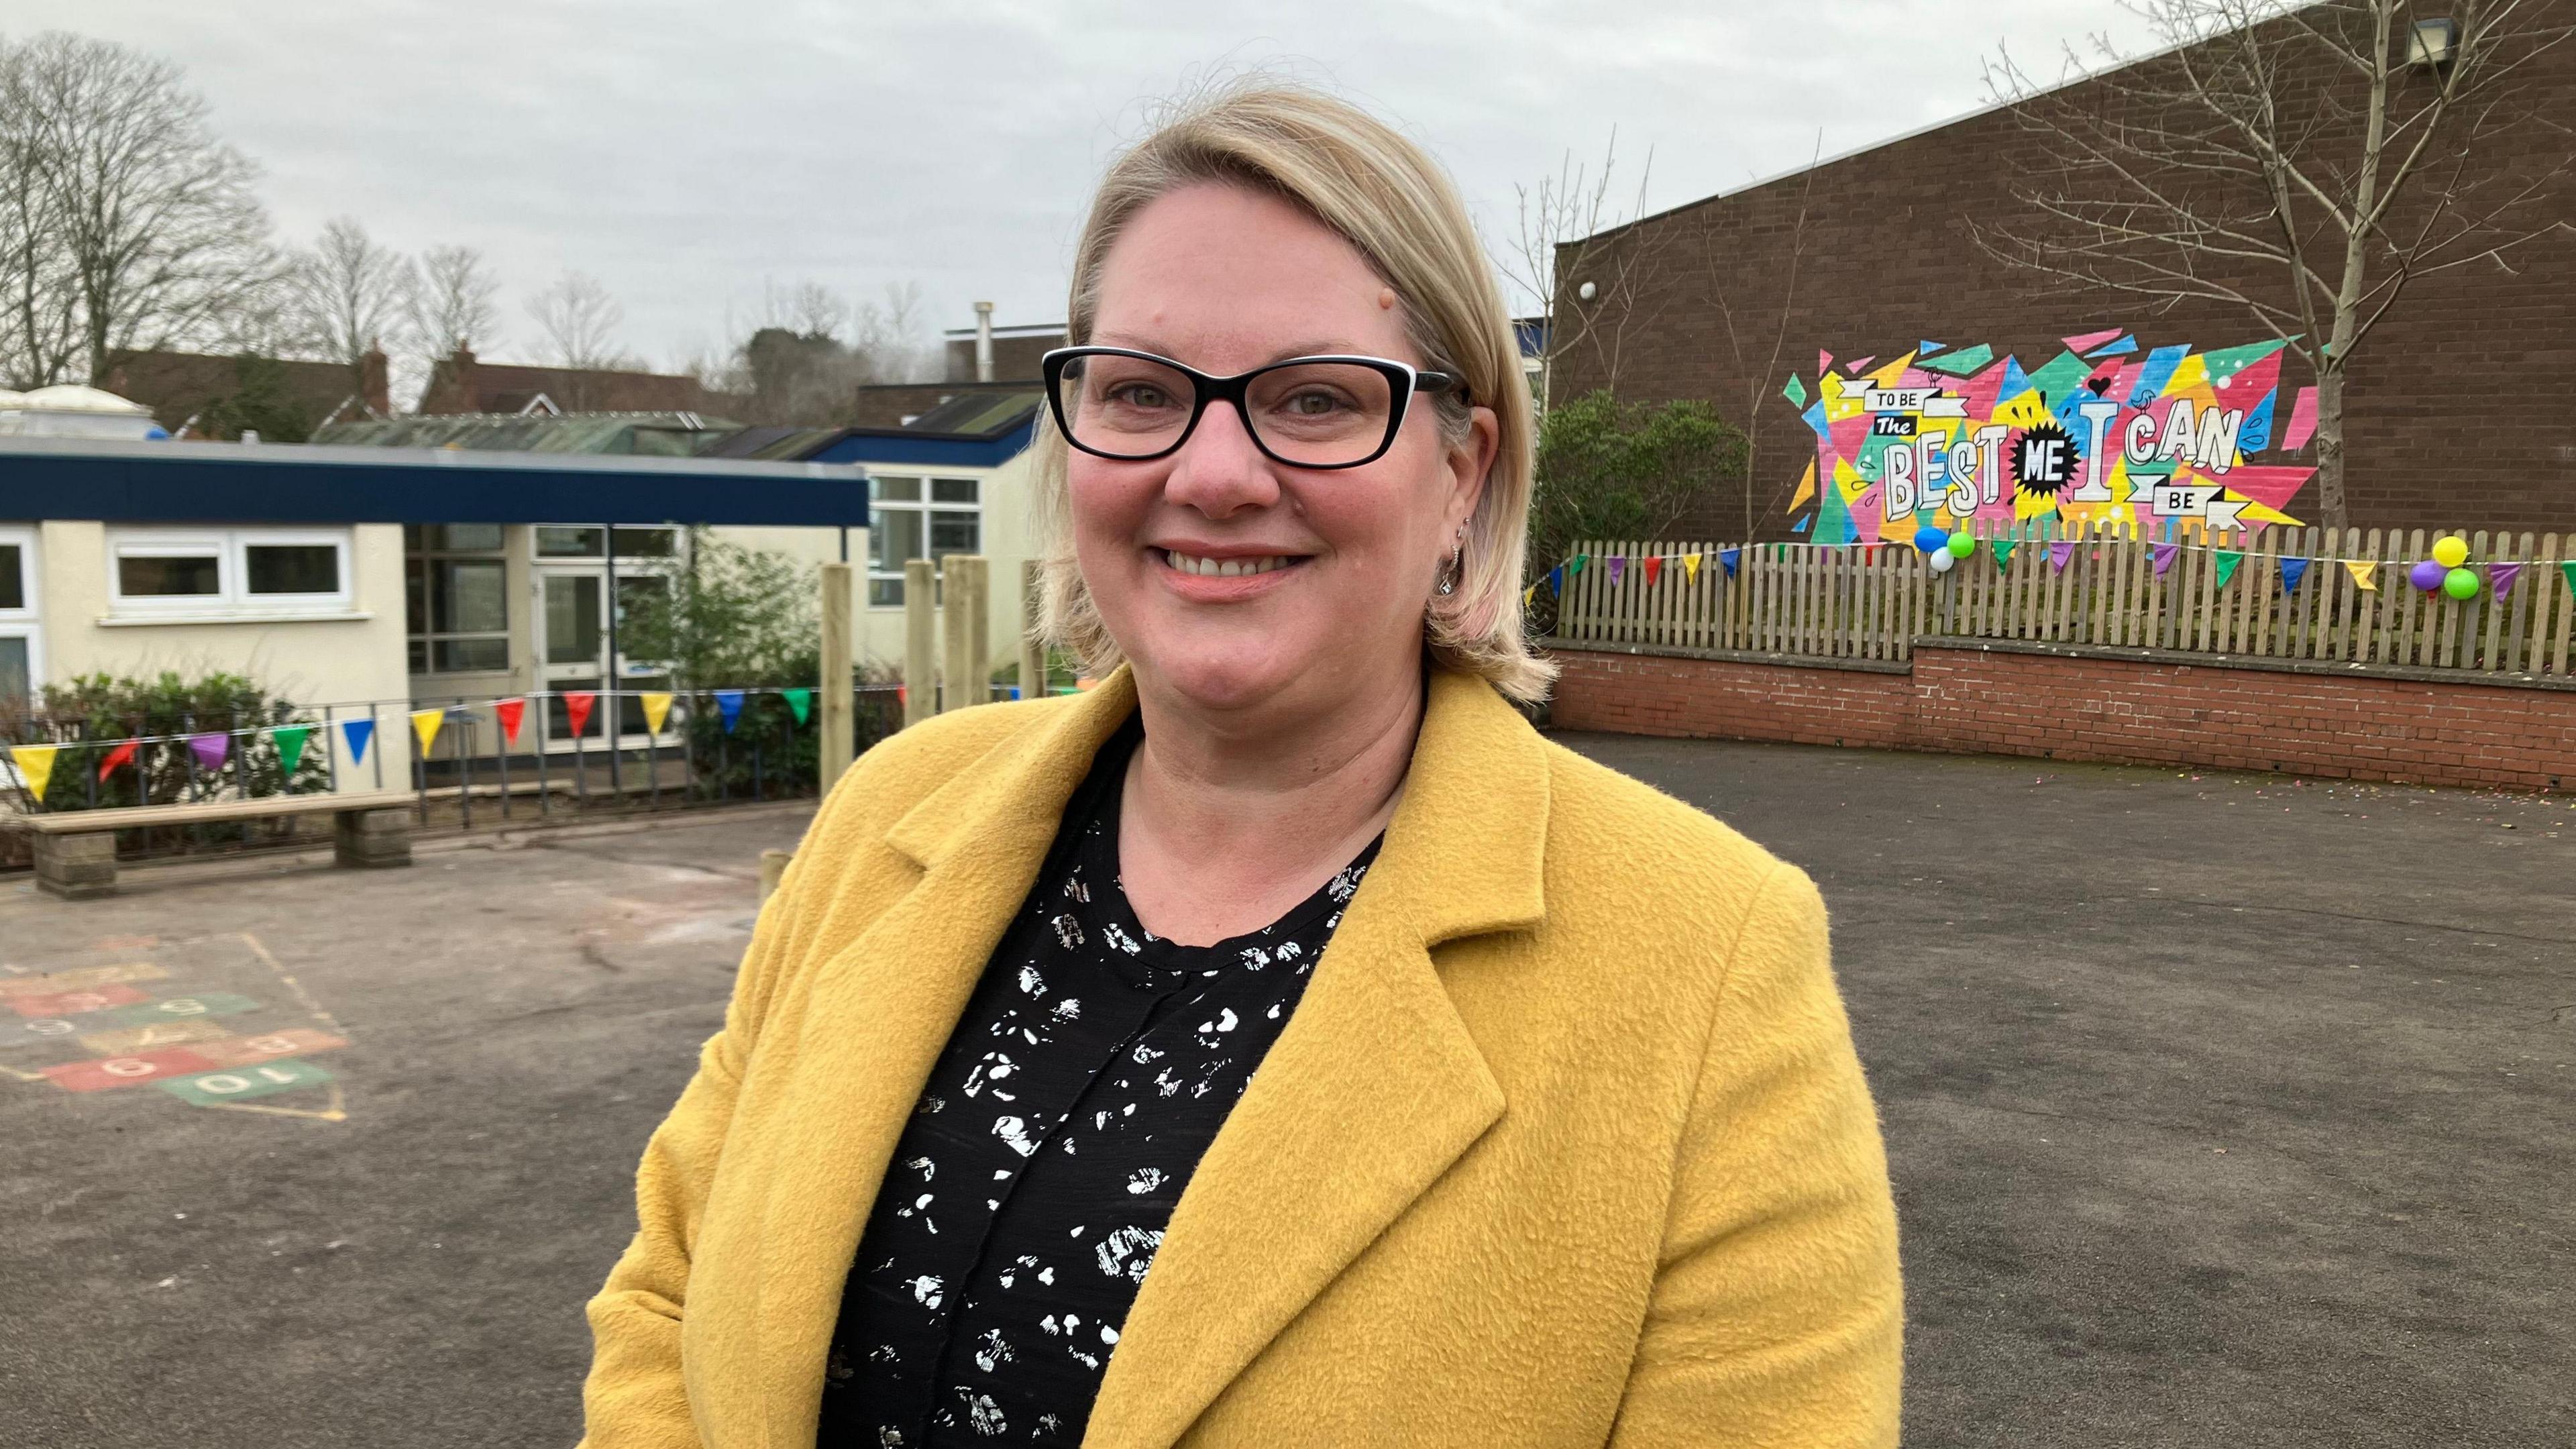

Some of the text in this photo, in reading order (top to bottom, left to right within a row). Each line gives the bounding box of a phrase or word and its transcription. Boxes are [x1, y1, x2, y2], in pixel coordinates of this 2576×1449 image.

[1877, 393, 1917, 407] TO BE
[1876, 417, 1911, 435] The
[2023, 439, 2065, 482] ME
[2074, 398, 2245, 502] I CAN
[1883, 424, 2008, 523] BEST
[2168, 492, 2195, 509] BE
[195, 1067, 301, 1094] 10
